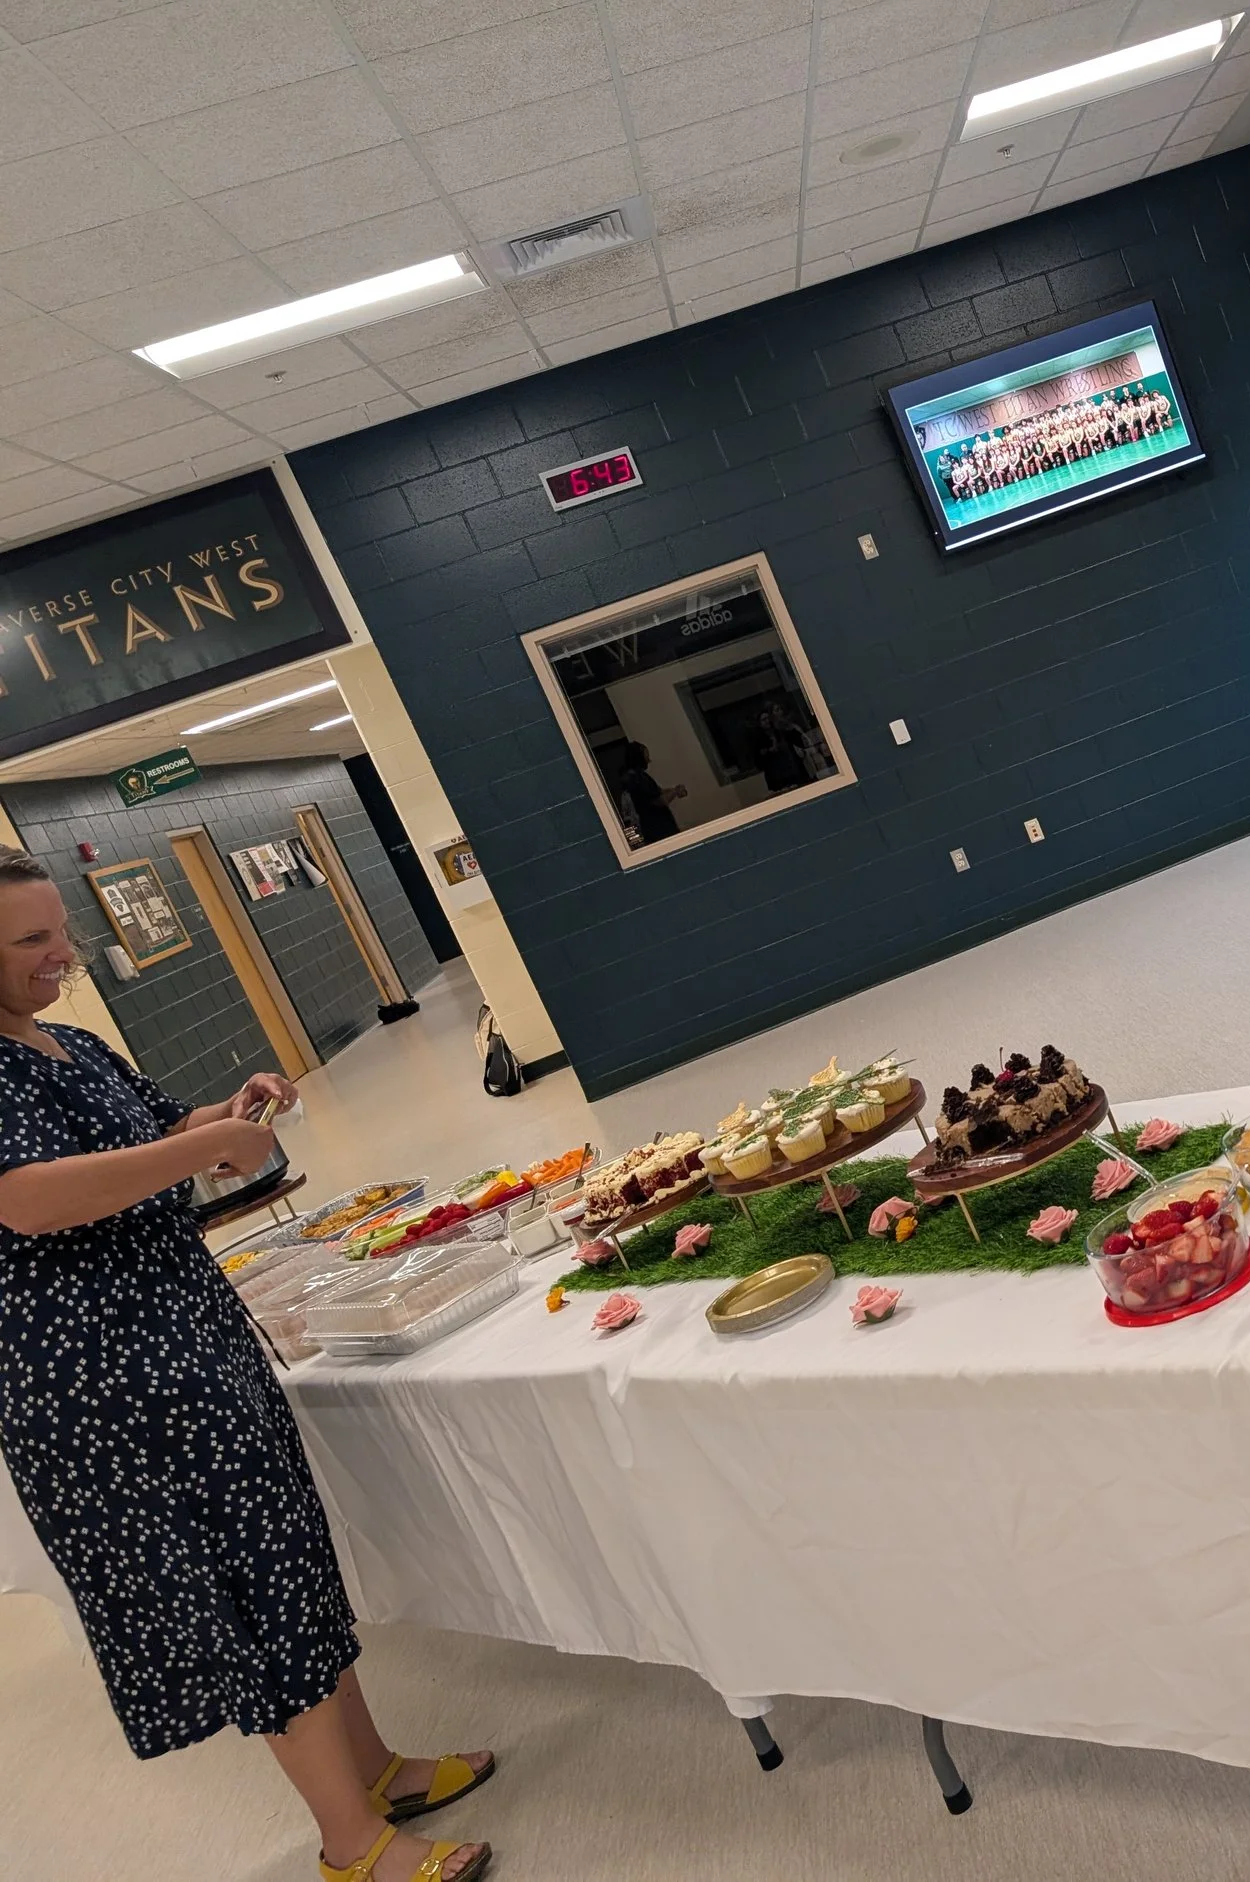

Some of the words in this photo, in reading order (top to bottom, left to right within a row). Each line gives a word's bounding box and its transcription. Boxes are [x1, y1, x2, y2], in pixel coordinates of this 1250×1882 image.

[933, 420, 958, 442] TC
[957, 402, 998, 431] WEST
[1000, 386, 1048, 420] TITAN
[1049, 358, 1134, 400] WRESTLING
[570, 454, 632, 496] 6:43
[110, 562, 174, 596] CITY
[188, 534, 260, 569] WEST
[0, 558, 285, 697] ITANS
[146, 757, 190, 778] RESTROOMS
